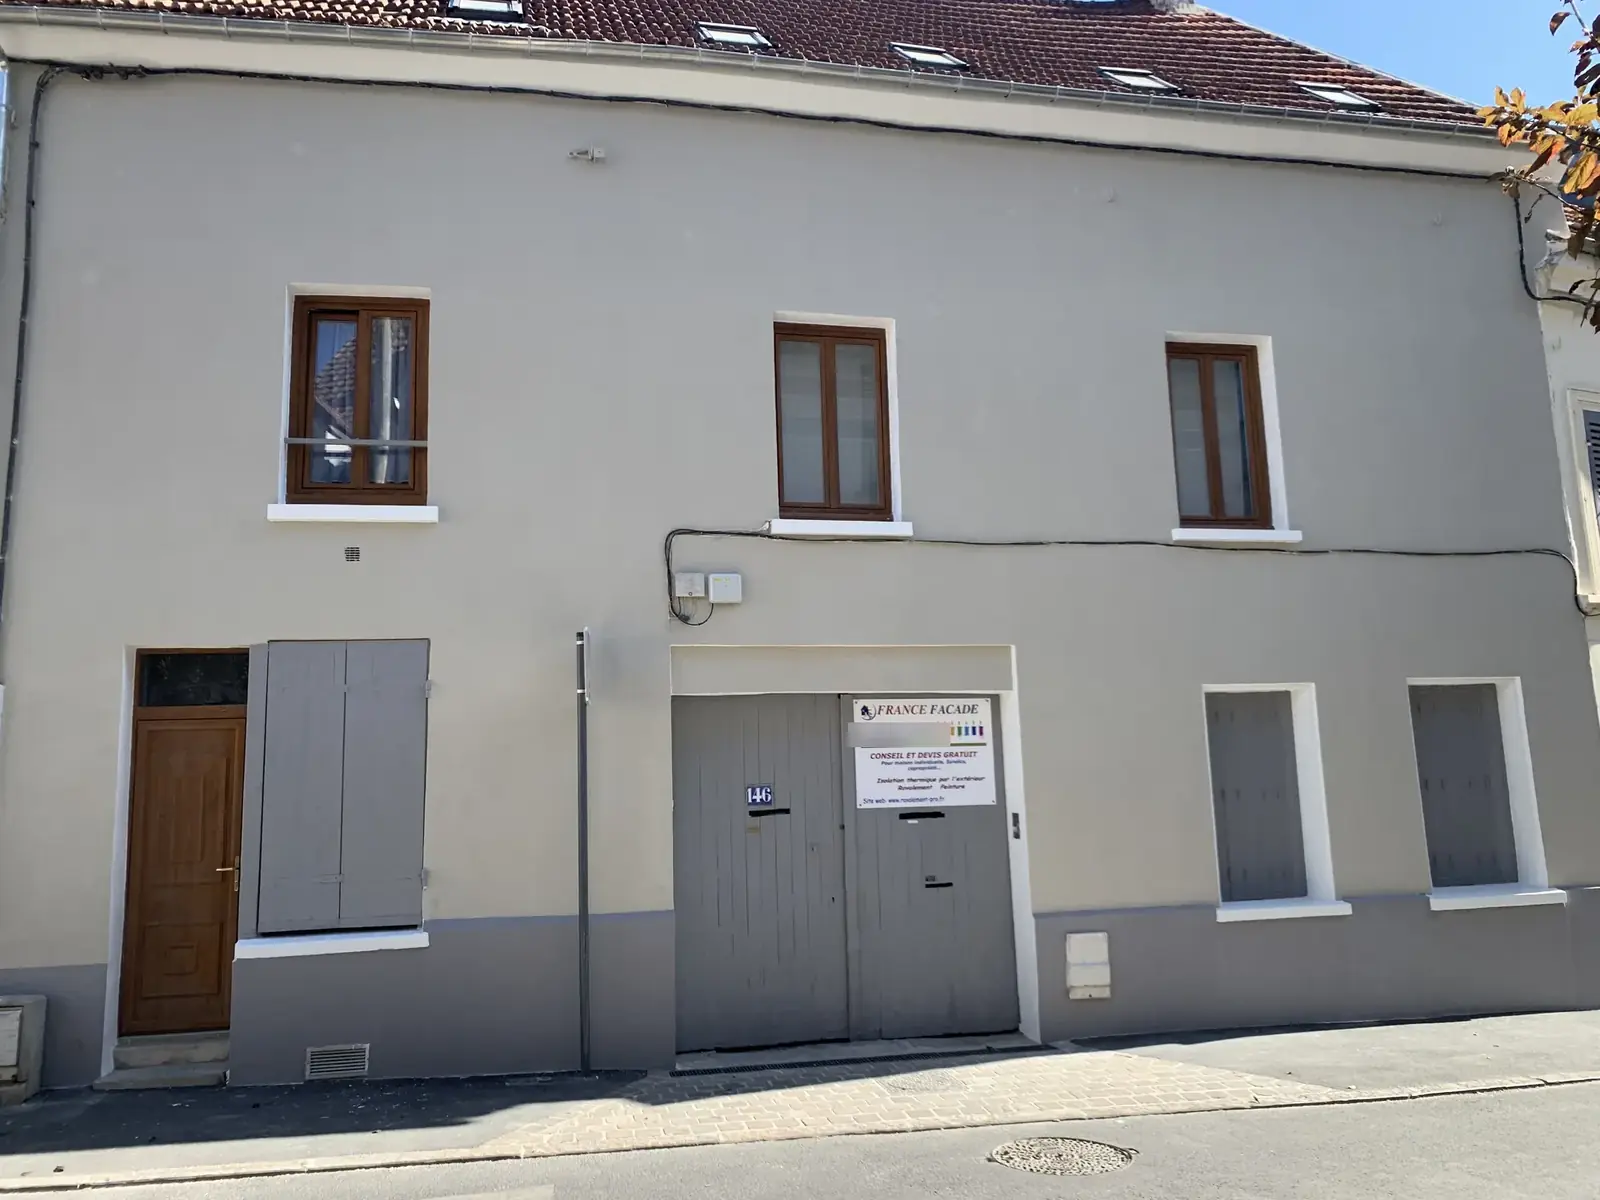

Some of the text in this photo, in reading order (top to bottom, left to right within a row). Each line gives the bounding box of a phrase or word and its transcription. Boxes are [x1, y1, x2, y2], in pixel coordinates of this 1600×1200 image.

[877, 704, 979, 715] FRANCE FACADE
[918, 751, 942, 759] DEVIS
[747, 787, 772, 803] 146
